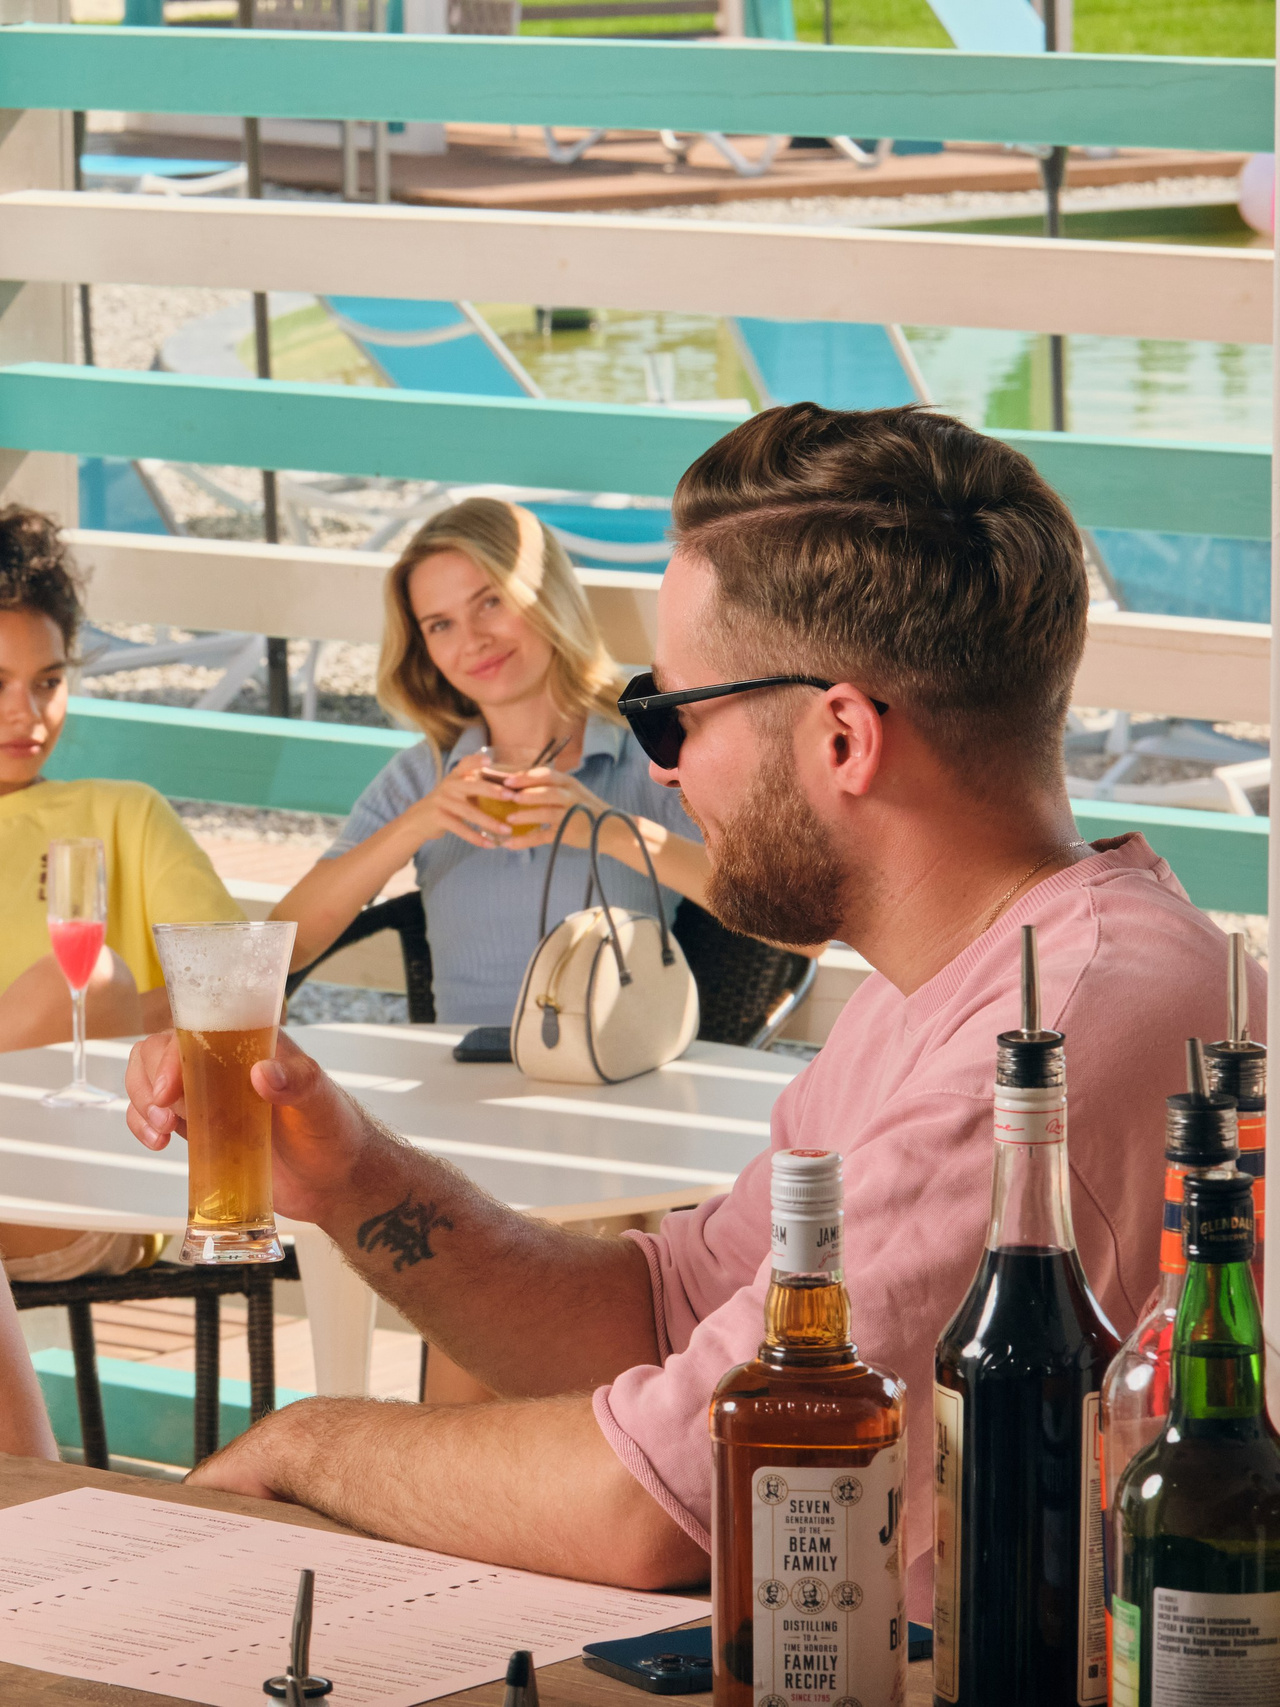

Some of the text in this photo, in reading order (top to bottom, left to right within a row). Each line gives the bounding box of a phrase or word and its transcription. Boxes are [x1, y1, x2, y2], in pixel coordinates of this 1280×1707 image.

[790, 1500, 830, 1514] SEVEN
[785, 1516, 835, 1525] GENERATIONS
[809, 1527, 821, 1535] THE
[789, 1536, 831, 1553] BEAM
[784, 1555, 838, 1572] FAMILY
[783, 1620, 838, 1632] DISTILLING
[784, 1643, 838, 1653] TIME HONORED
[784, 1654, 838, 1671] FAMILY
[785, 1673, 836, 1690] RECIPE
[791, 1693, 812, 1702] SINCE
[814, 1694, 830, 1702] 1795
